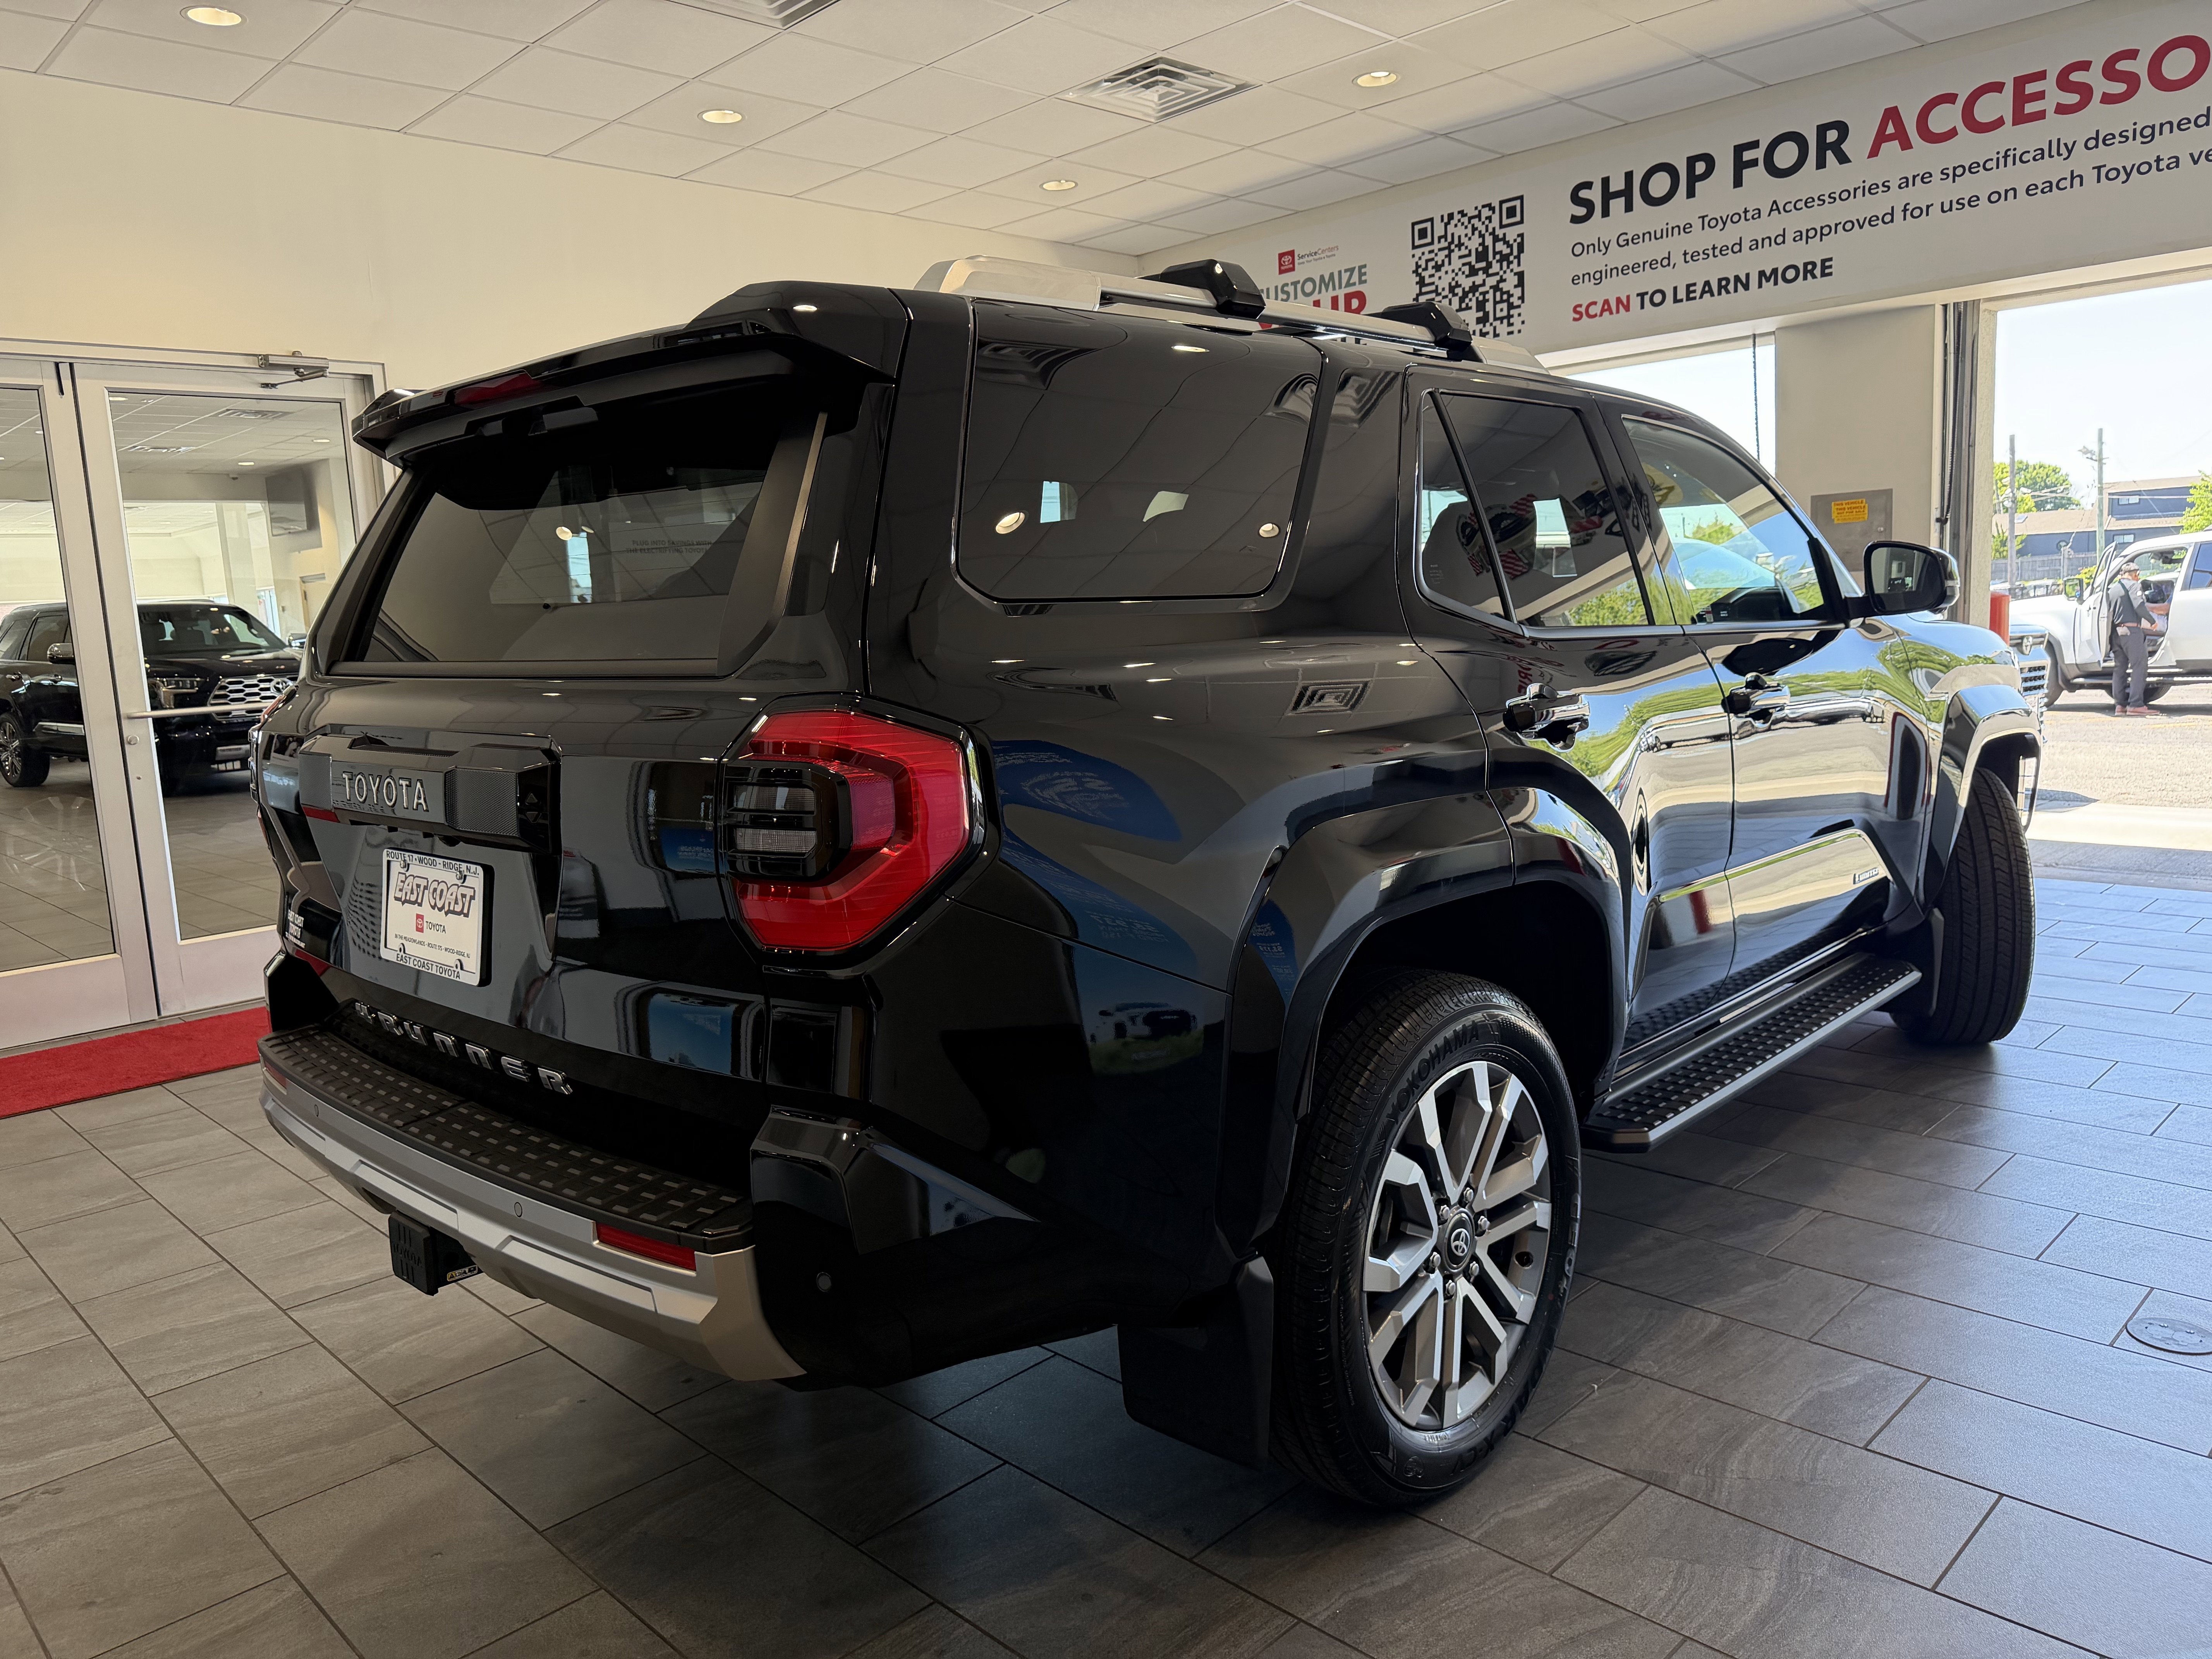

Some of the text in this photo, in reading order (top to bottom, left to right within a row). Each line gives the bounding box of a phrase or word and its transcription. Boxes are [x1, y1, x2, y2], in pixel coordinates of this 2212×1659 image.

[1570, 35, 2211, 225] SHOP FOR ACCESSO
[1571, 106, 2211, 257] Only Genuine Toyota Accessories are specifically designed
[1571, 251, 1676, 285] engineered,
[1682, 236, 1742, 264] tested
[1749, 227, 1786, 251] and
[1793, 205, 1894, 245] approved
[1901, 202, 1934, 221] for
[1941, 195, 1980, 213] use
[1987, 187, 2017, 204] on
[2025, 169, 2083, 197] each
[2092, 155, 2180, 184] Toyota
[1572, 257, 1833, 322] SCAN TO LEARN MORE
[343, 771, 429, 812] TOYOTA
[386, 850, 406, 861] ROUTE
[408, 854, 413, 862] 17
[417, 856, 437, 867] WOOD
[466, 865, 479, 875] N.J.
[394, 872, 476, 918] EAST COAST
[404, 936, 425, 946] MEADOWLANDS
[426, 921, 446, 934] TOYOTA
[396, 953, 460, 979] EAST COAST TOYOTA
[355, 1002, 573, 1095] 4RUNNER
[1386, 1021, 1480, 1122] YOKOHAMA
